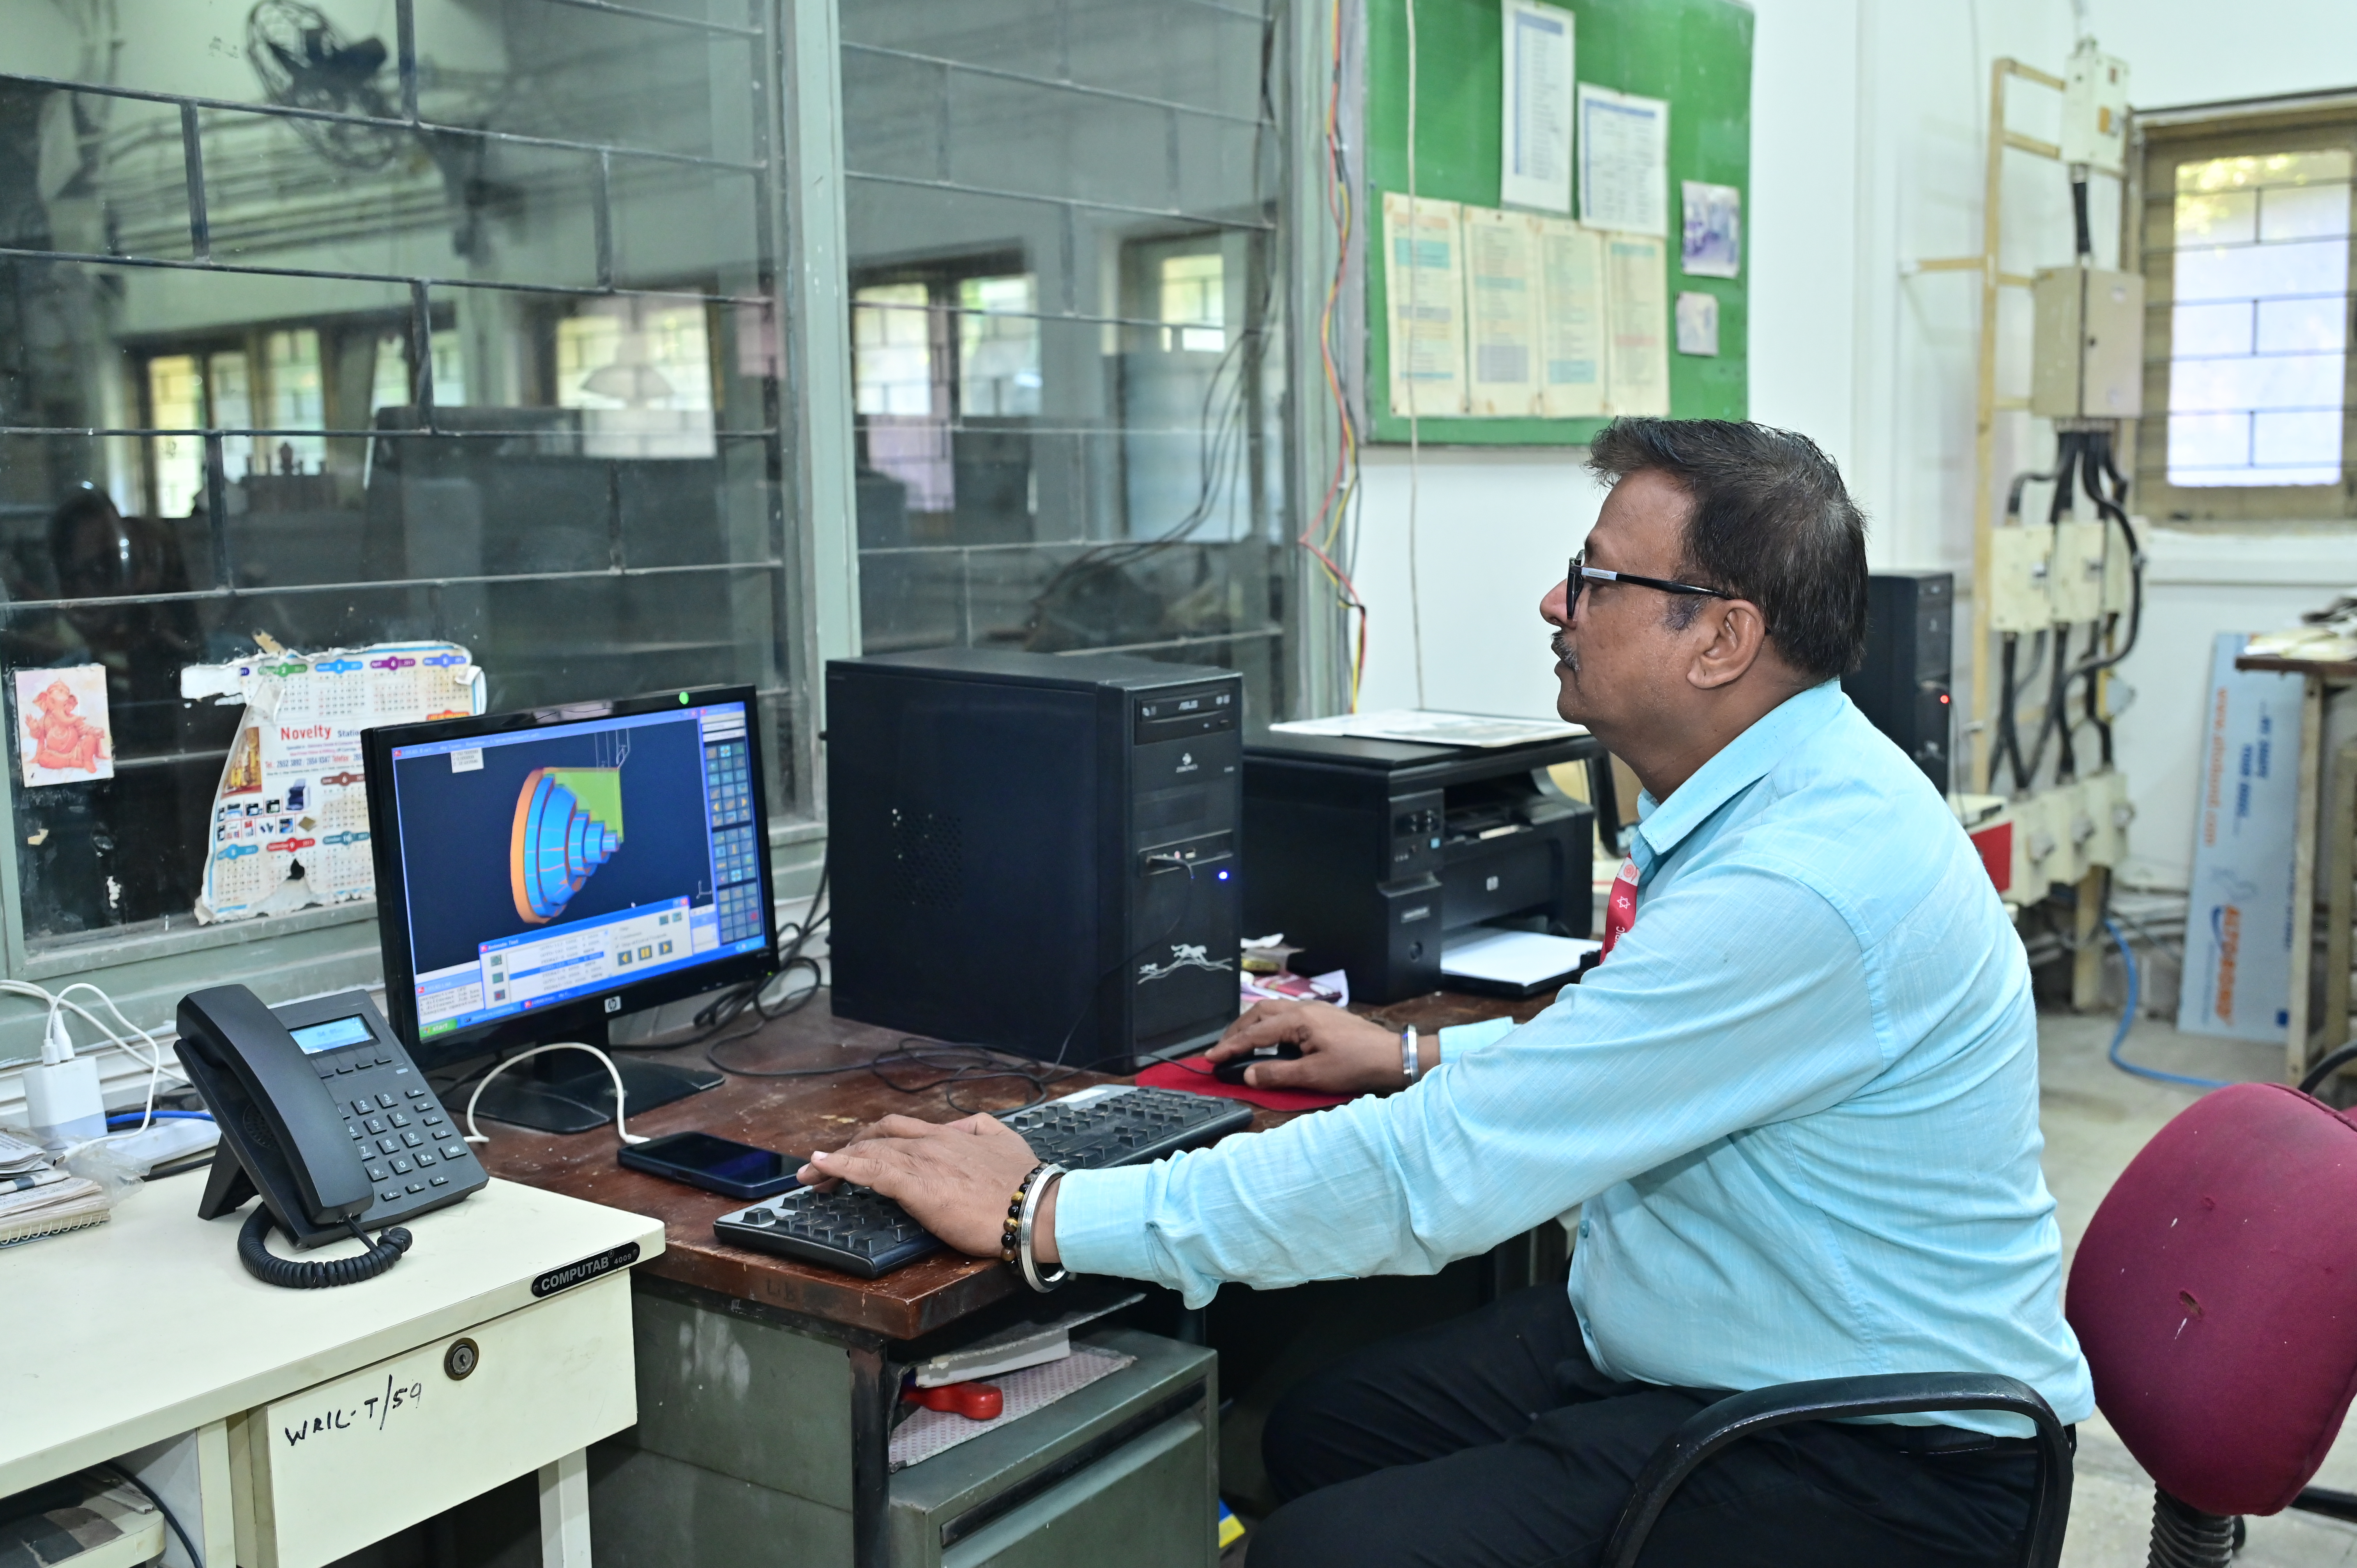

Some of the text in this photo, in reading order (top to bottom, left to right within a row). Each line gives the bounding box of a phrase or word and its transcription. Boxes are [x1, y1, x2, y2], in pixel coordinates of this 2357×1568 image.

[281, 725, 361, 741] Novelty Statio
[433, 1023, 448, 1031] start
[541, 1256, 609, 1291] COMPUTAB
[614, 1253, 632, 1264] 4009
